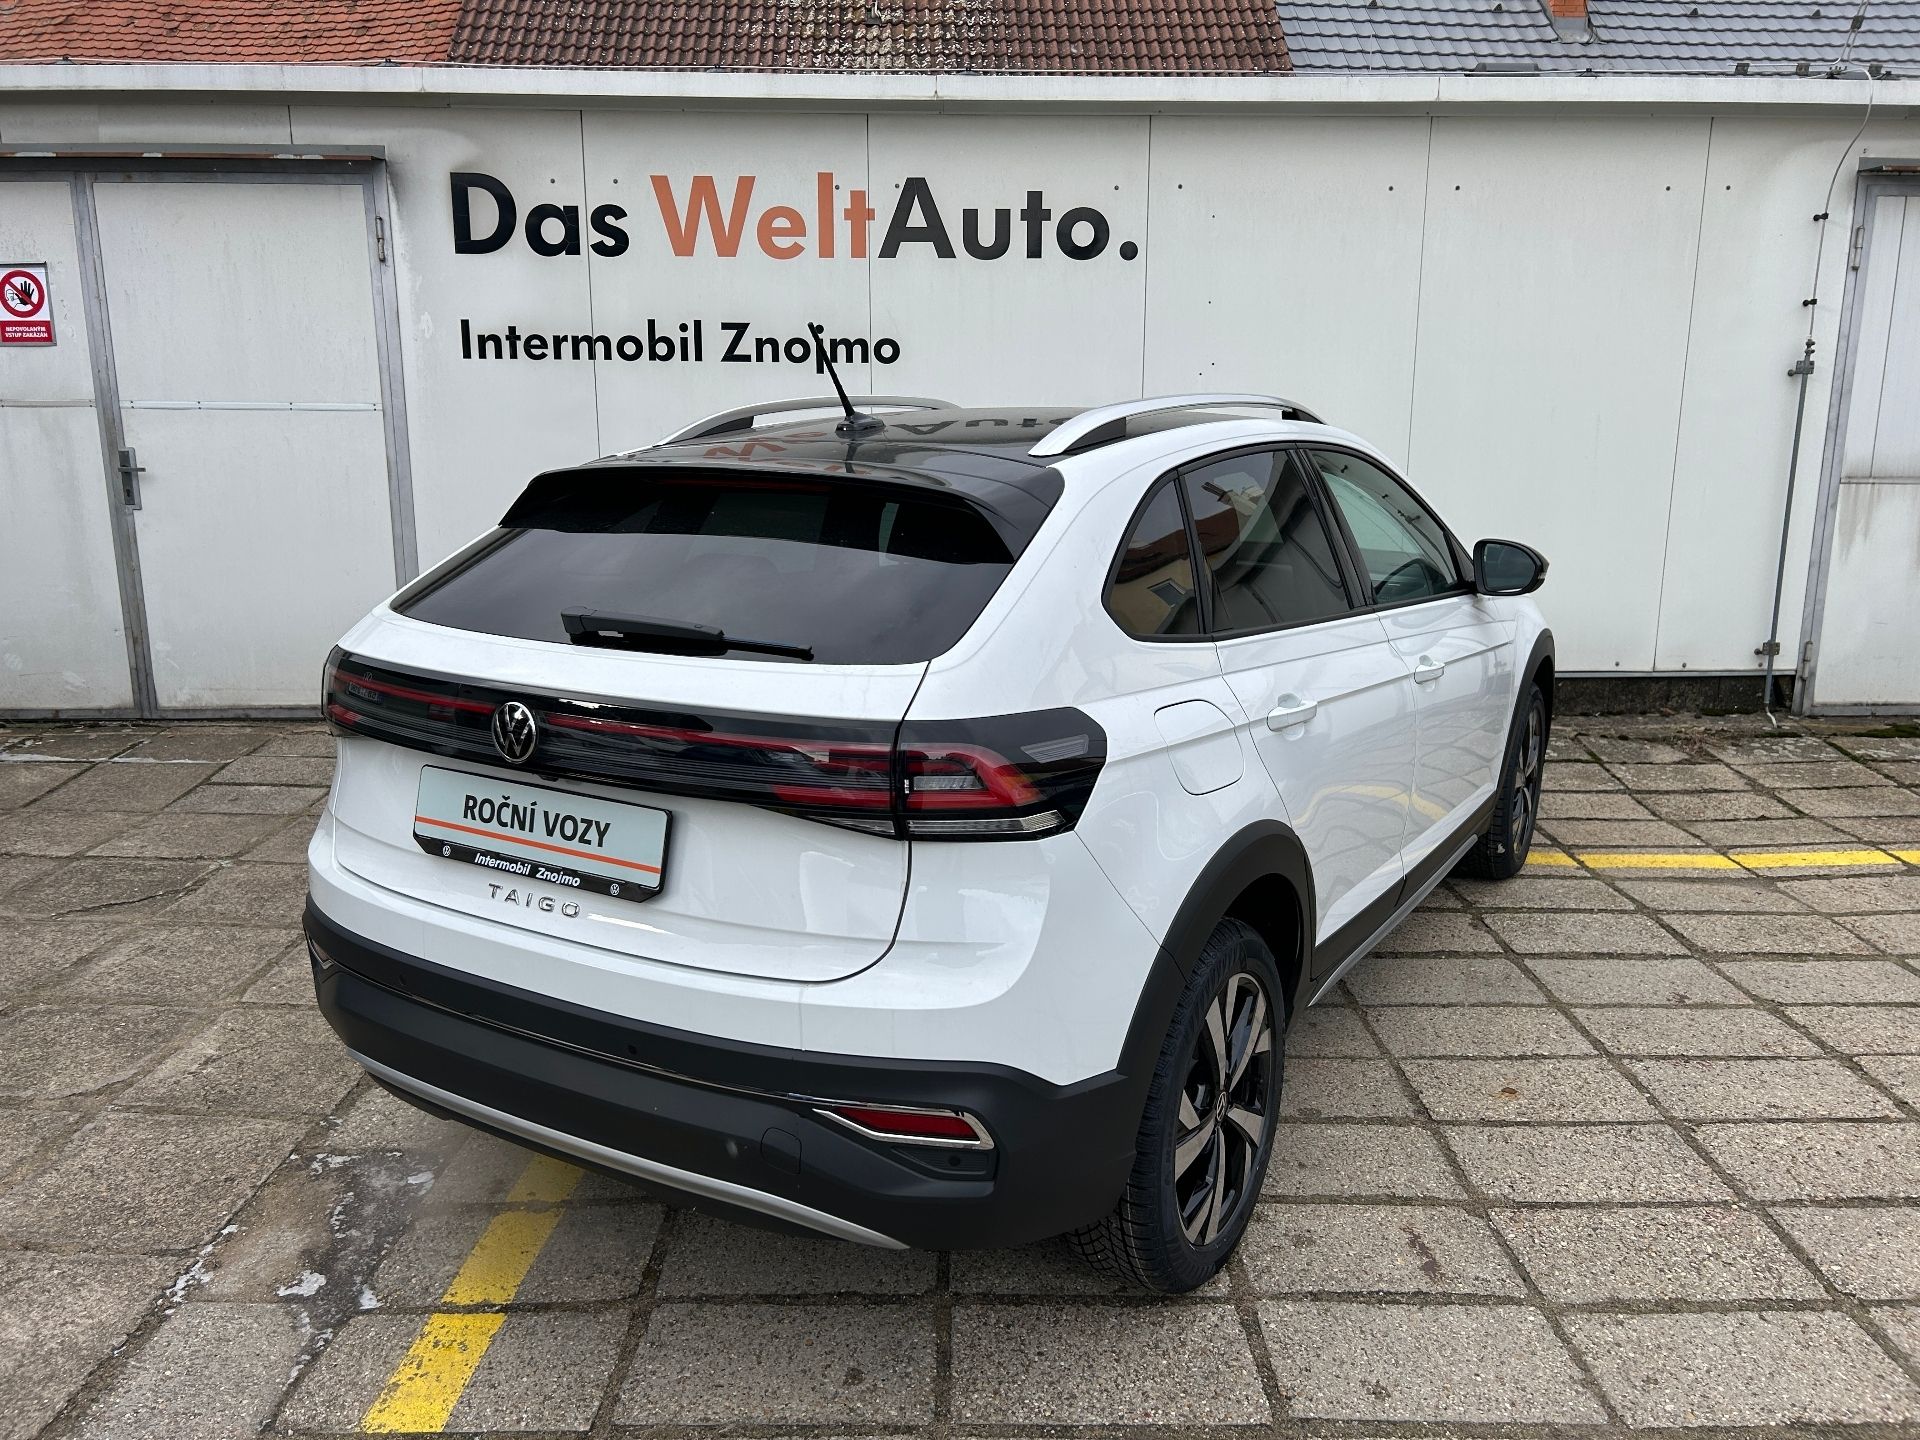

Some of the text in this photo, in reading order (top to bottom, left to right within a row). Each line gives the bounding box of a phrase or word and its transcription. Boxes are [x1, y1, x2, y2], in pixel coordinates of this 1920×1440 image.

[449, 171, 1139, 261] Das WeltAuto.
[460, 318, 901, 375] Intermobil Znojmo
[463, 794, 612, 848] ROČNÍ VOZY
[474, 852, 581, 888] Intermobil Znojmo
[488, 882, 581, 919] TAIGO
